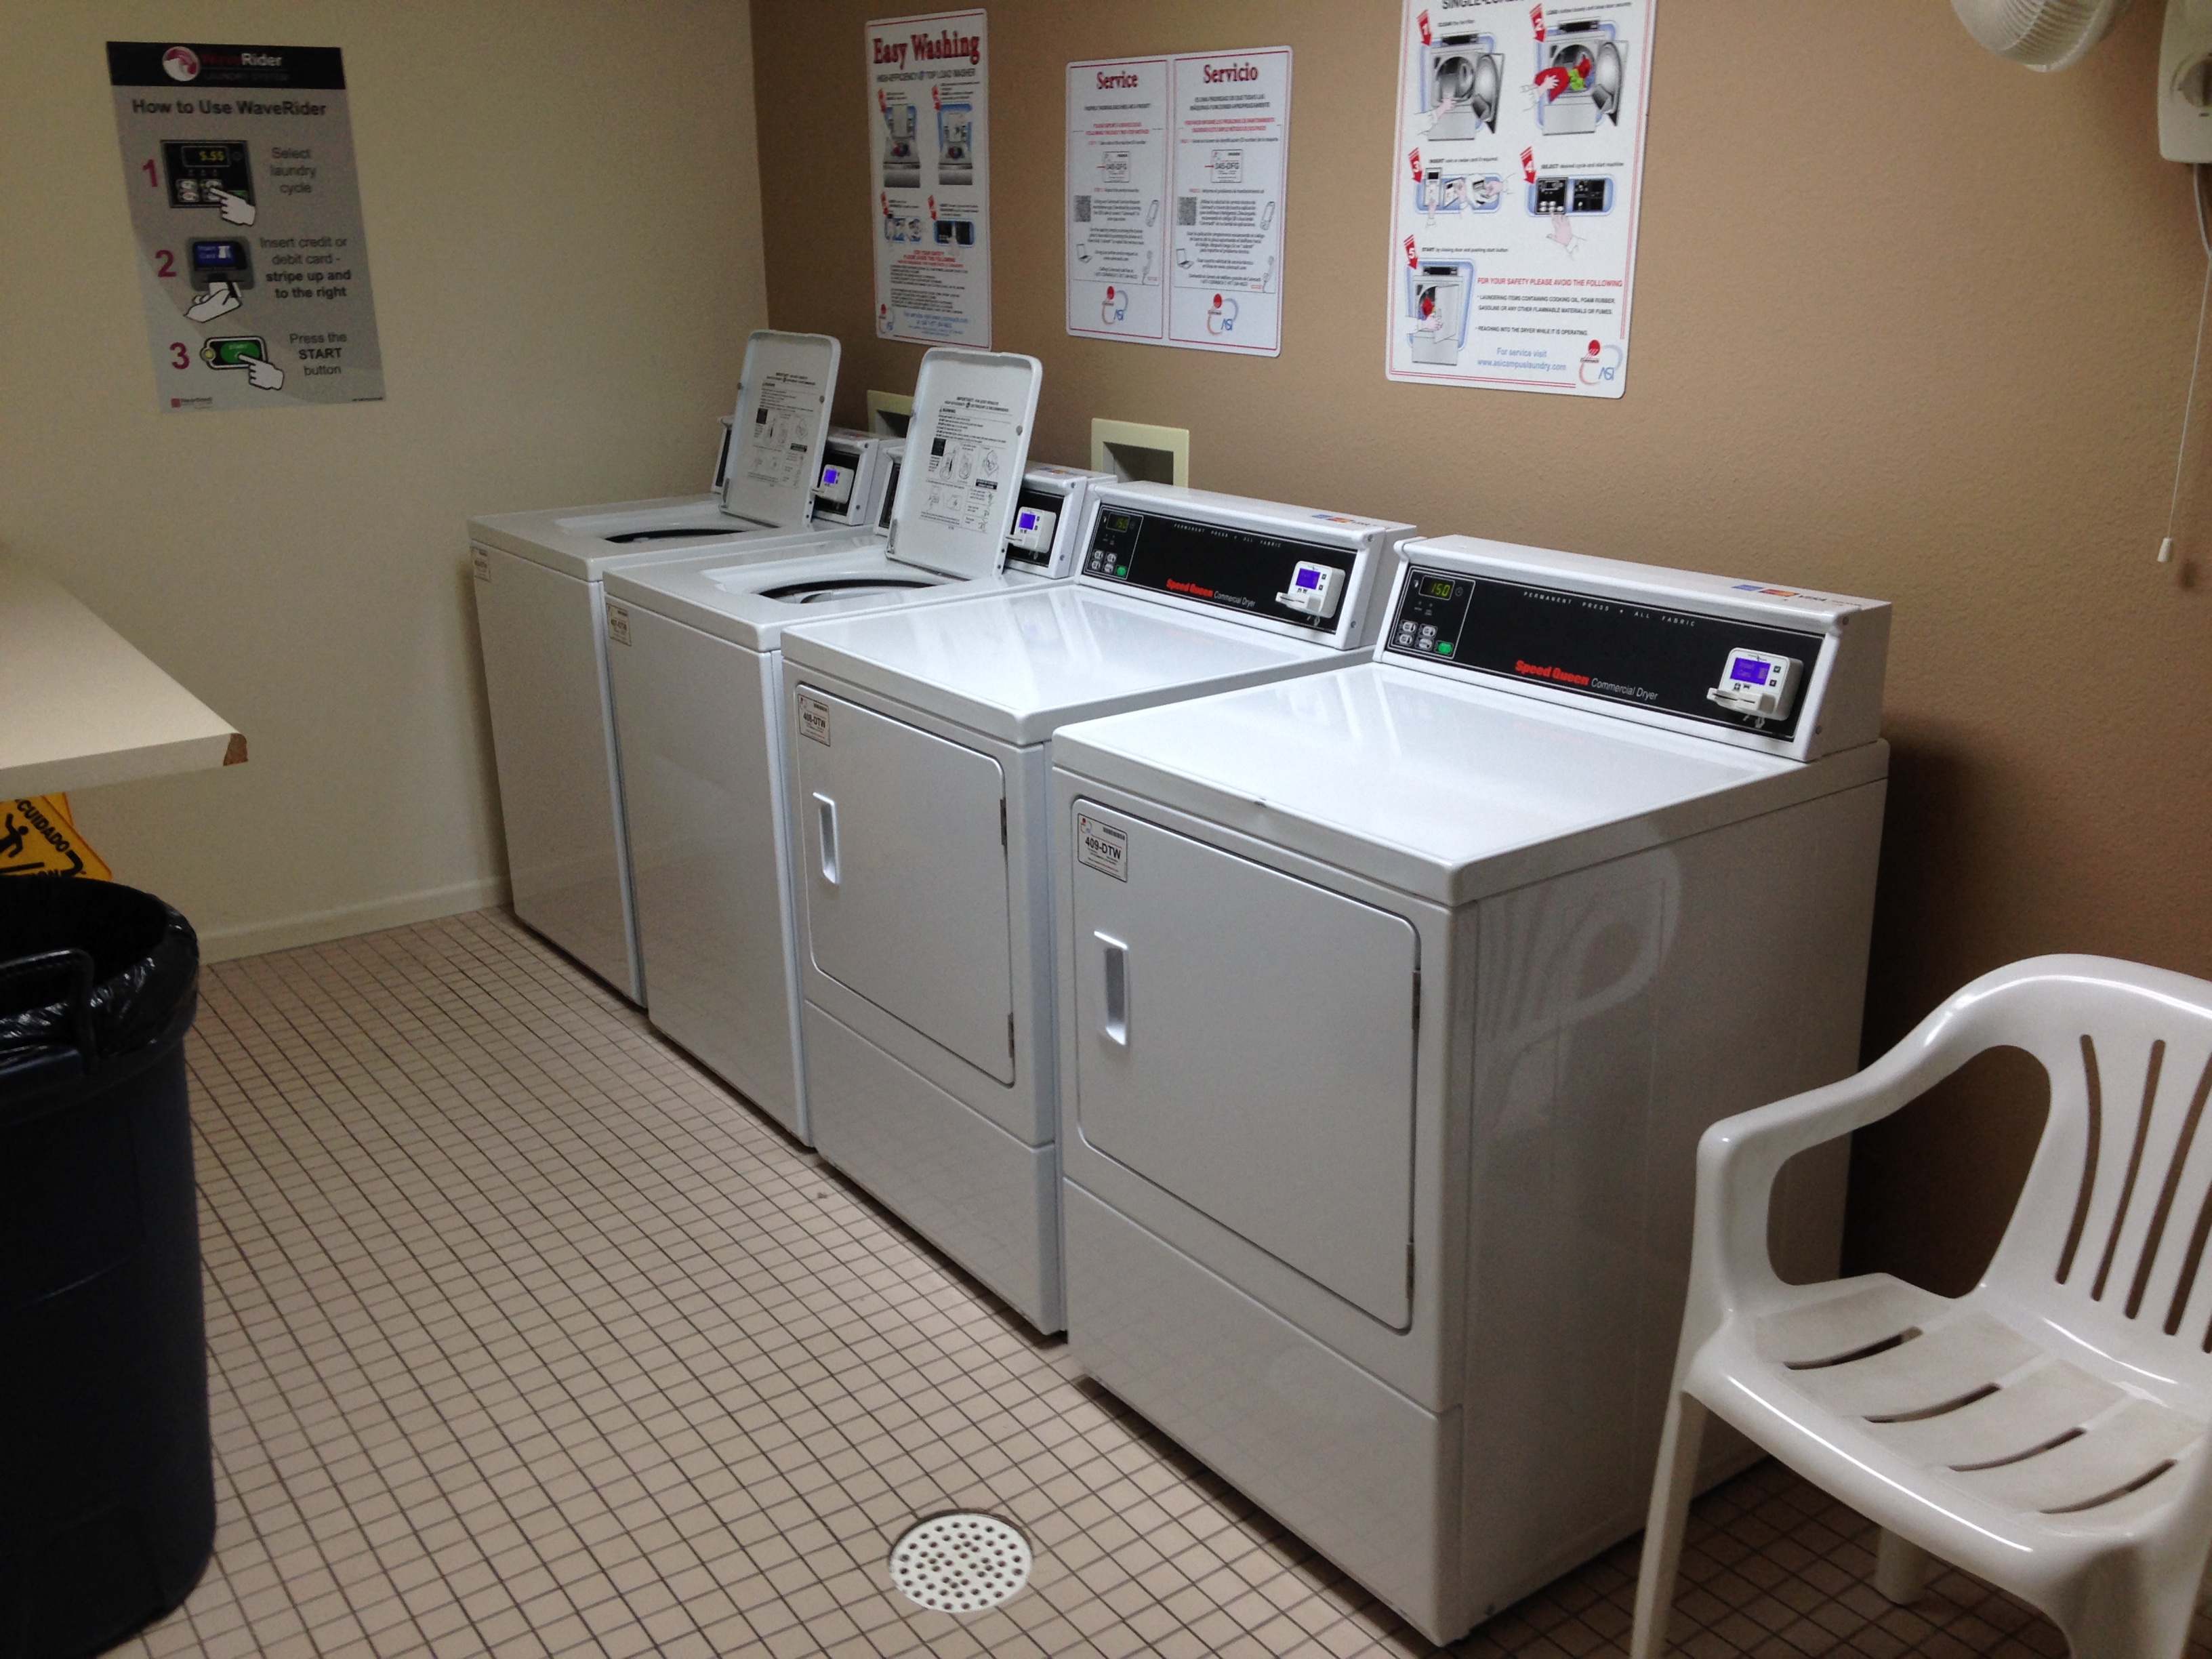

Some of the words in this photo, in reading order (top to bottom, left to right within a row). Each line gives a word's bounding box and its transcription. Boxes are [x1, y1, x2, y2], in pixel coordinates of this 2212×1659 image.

[1534, 18, 1543, 31] 2
[872, 37, 908, 70] Easy
[910, 29, 980, 65] Washing
[1097, 70, 1139, 90] Service
[1203, 61, 1258, 84] Servicio
[132, 100, 170, 114] How
[176, 100, 193, 114] to
[199, 100, 232, 115] Use
[235, 100, 327, 116] WaveRider
[272, 147, 311, 159] Select
[142, 159, 158, 187] 1
[271, 165, 316, 179] laundry
[280, 182, 312, 196] cycle
[260, 237, 294, 248] Insert
[298, 236, 333, 248] credit
[335, 238, 347, 247] or
[272, 254, 303, 265] debit
[306, 254, 333, 264] card
[1408, 248, 1415, 259] 5
[155, 249, 177, 278] 2
[265, 271, 303, 284] stripe
[307, 272, 324, 284] up
[327, 269, 351, 281] and
[275, 288, 289, 299] to
[292, 287, 313, 298] the
[316, 286, 347, 300] right
[289, 332, 325, 345] Press
[327, 331, 347, 343] the
[169, 342, 190, 369] 3
[298, 347, 342, 361] START
[1497, 347, 1508, 355] For
[1509, 348, 1531, 357] service
[1533, 349, 1547, 358] visit
[304, 363, 342, 376] button
[1174, 523, 1205, 533] PERMANENT
[1260, 540, 1282, 548] FABRIC
[1166, 578, 1190, 592] Speed
[1190, 583, 1214, 598] Queen
[1214, 590, 1242, 605] Commercial
[1242, 597, 1256, 608] Dryer
[1431, 582, 1451, 597] 150
[1523, 591, 1572, 605] PERMANENT
[1582, 601, 1610, 611] PRESS
[1634, 611, 1650, 619] ALL
[1661, 615, 1695, 627] FABRIC
[1515, 659, 1552, 678] Speed
[1552, 668, 1590, 686] Queen
[1591, 677, 1636, 696] Commercial
[1636, 687, 1659, 701] Dryer
[16, 799, 70, 853] CUIDADO
[1085, 836, 1121, 860] 409-DTW
